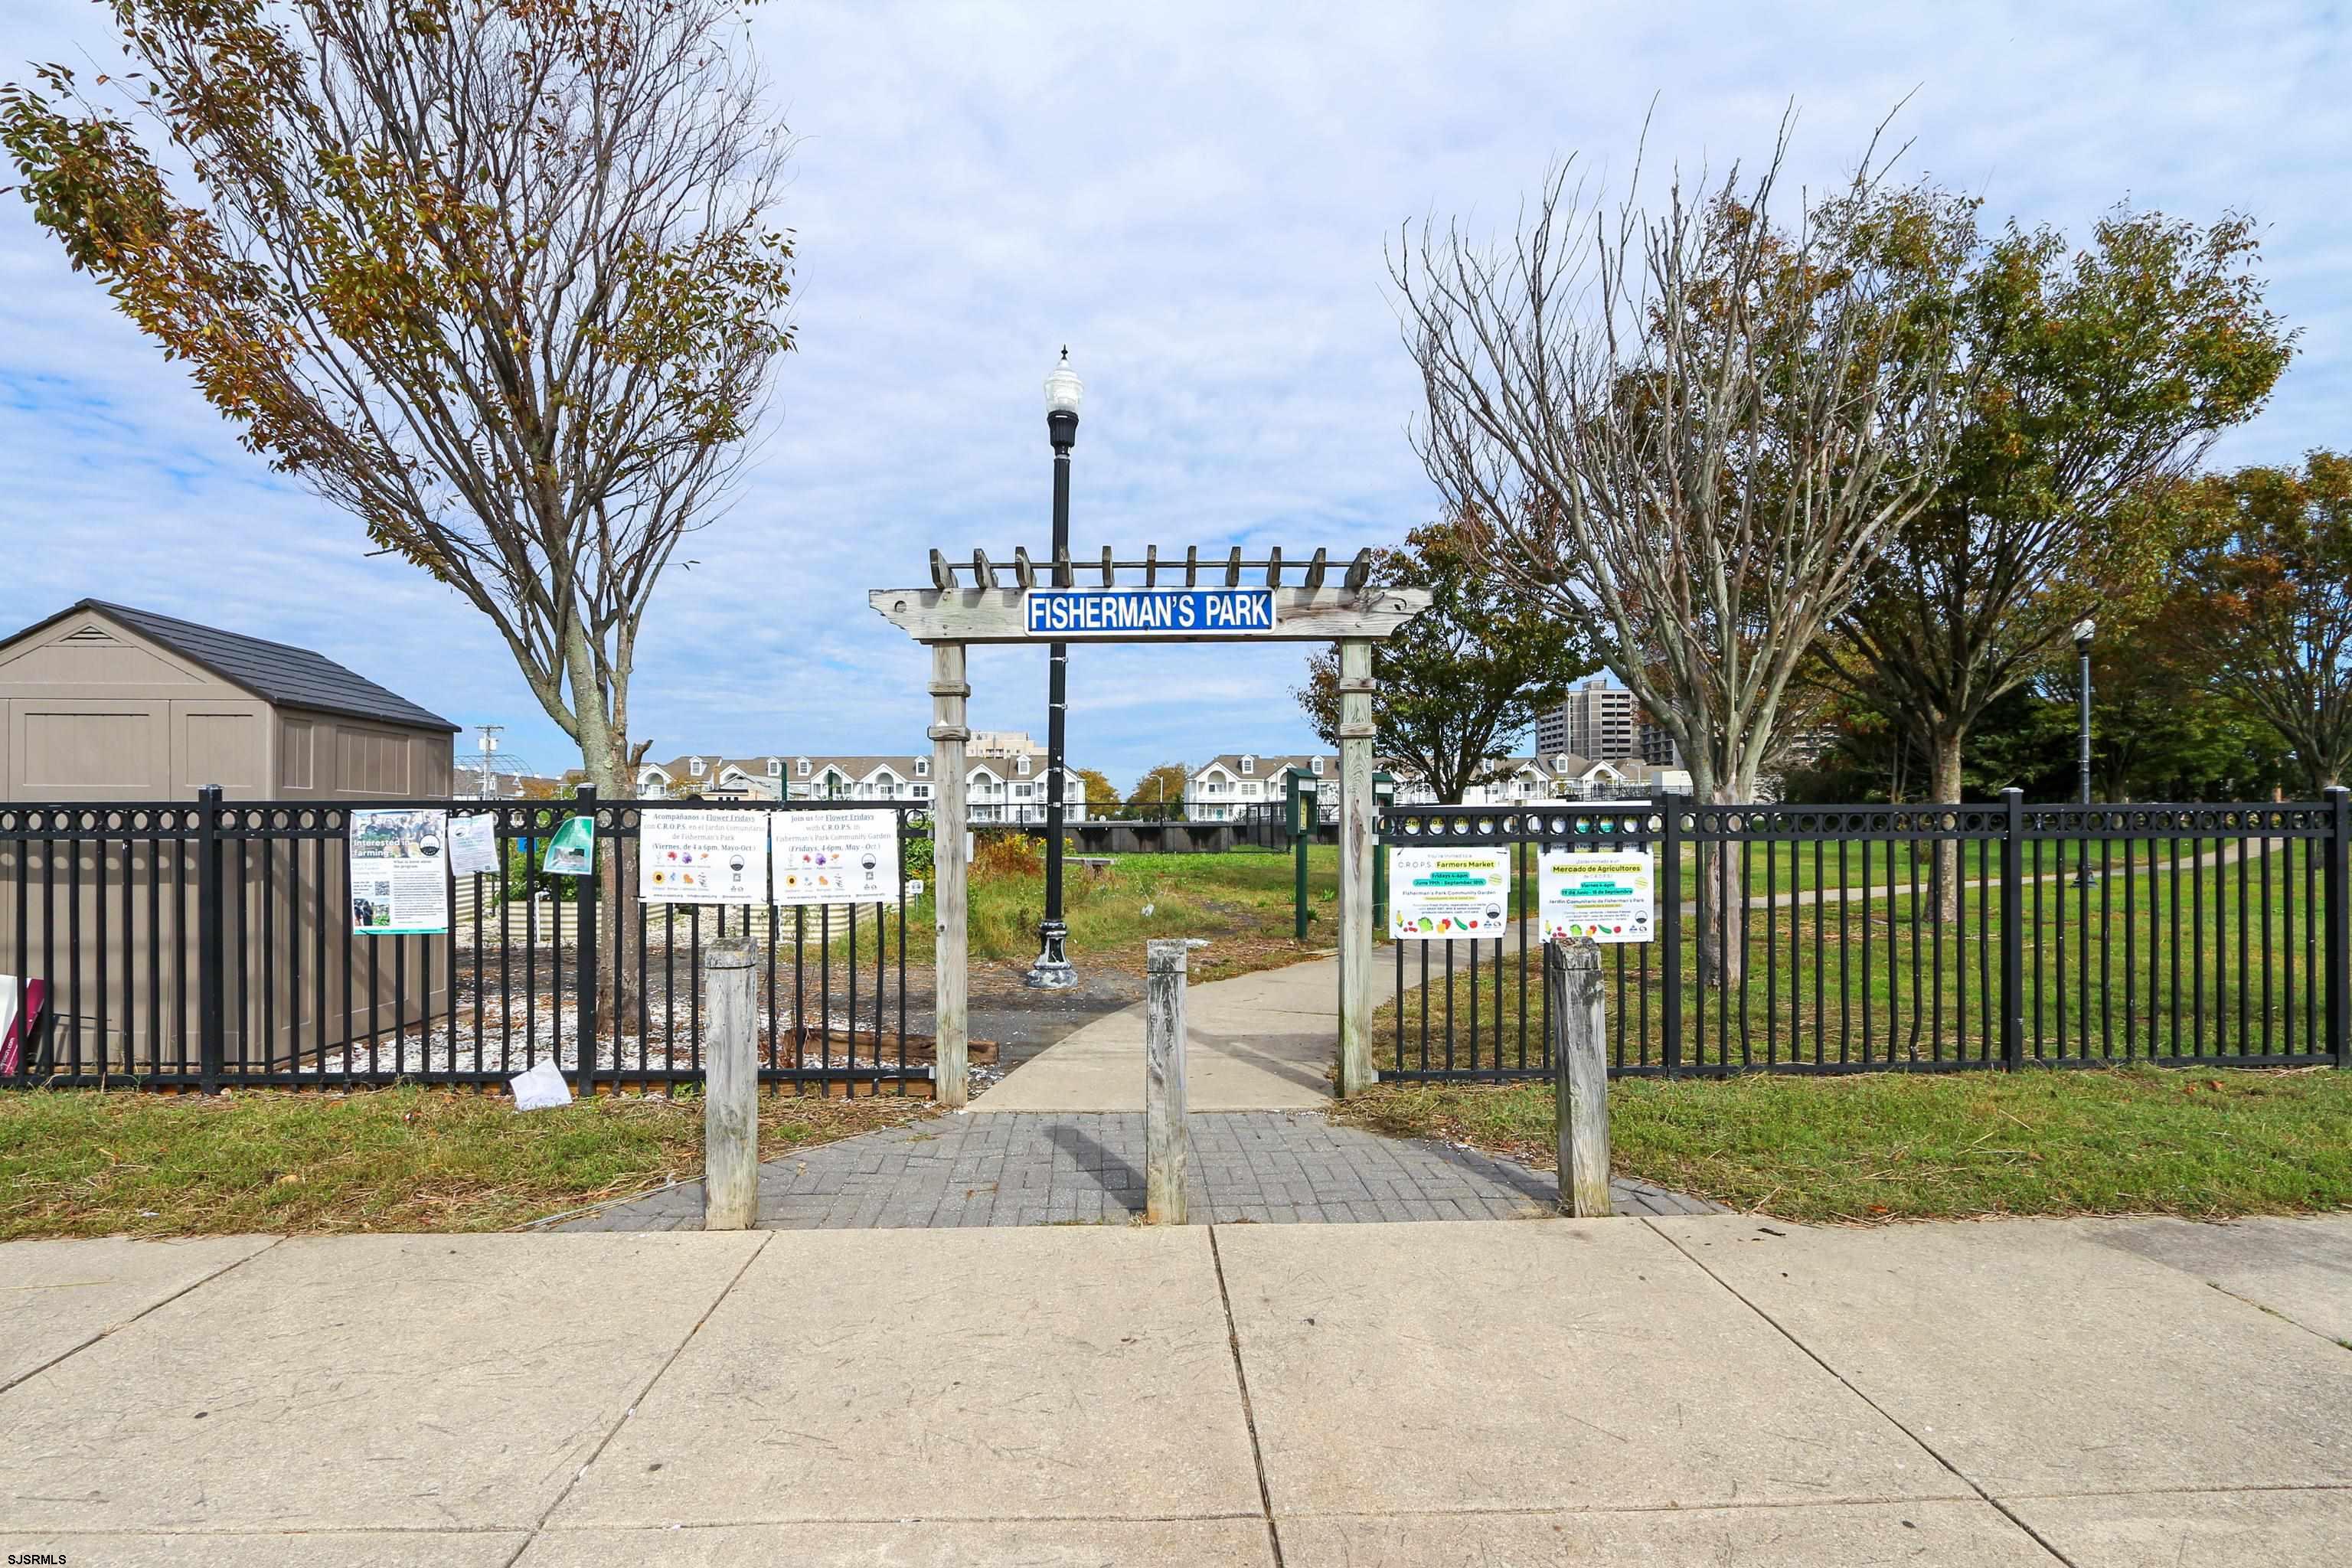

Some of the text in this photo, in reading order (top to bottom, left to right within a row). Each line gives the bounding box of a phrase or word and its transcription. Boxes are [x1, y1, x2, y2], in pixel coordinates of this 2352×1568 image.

[1031, 594, 1269, 629] FISHERMAN'S PARK
[791, 815, 804, 823] Join
